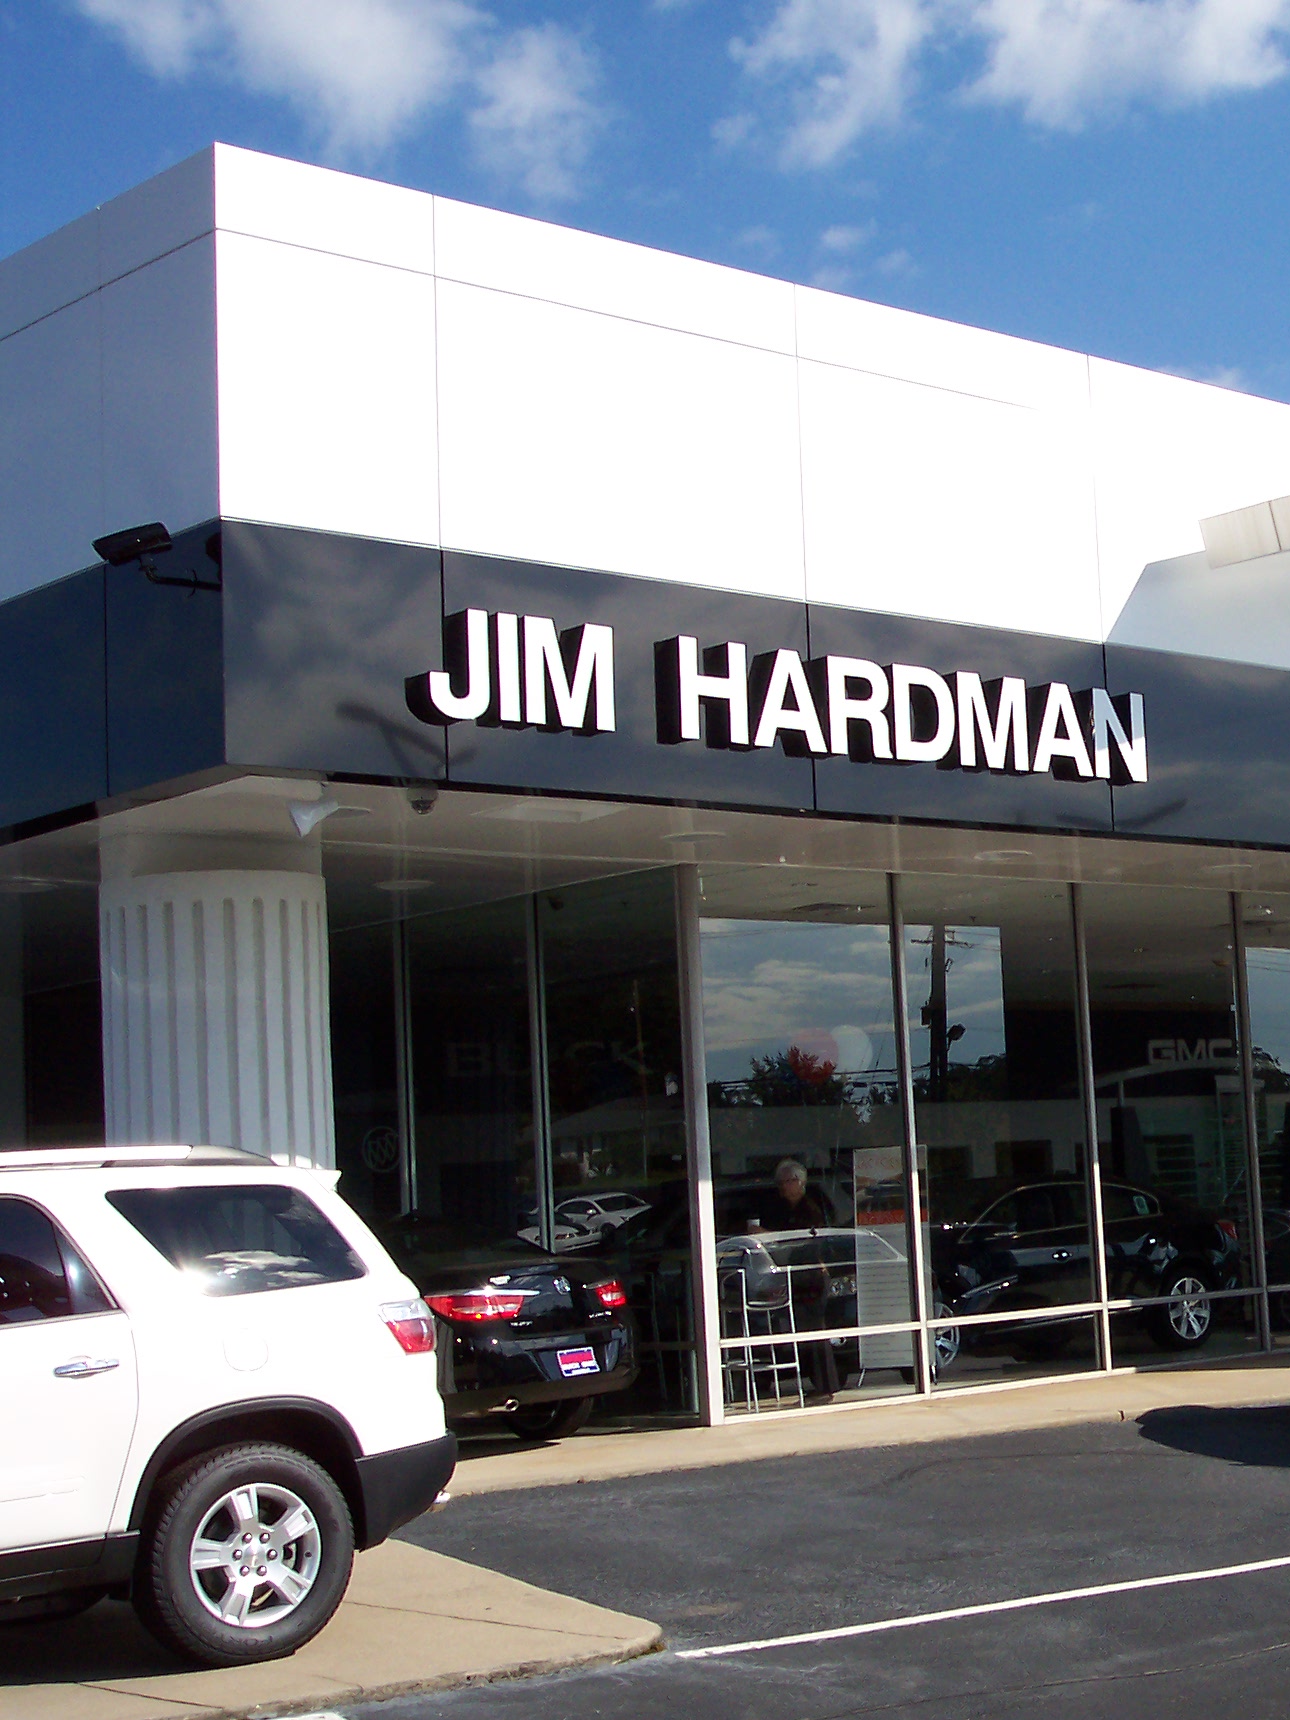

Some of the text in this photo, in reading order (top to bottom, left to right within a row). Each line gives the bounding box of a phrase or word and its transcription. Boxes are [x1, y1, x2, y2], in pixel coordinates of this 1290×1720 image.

[428, 608, 1147, 783] JIM HARDMAN
[1147, 1038, 1237, 1065] GMC
